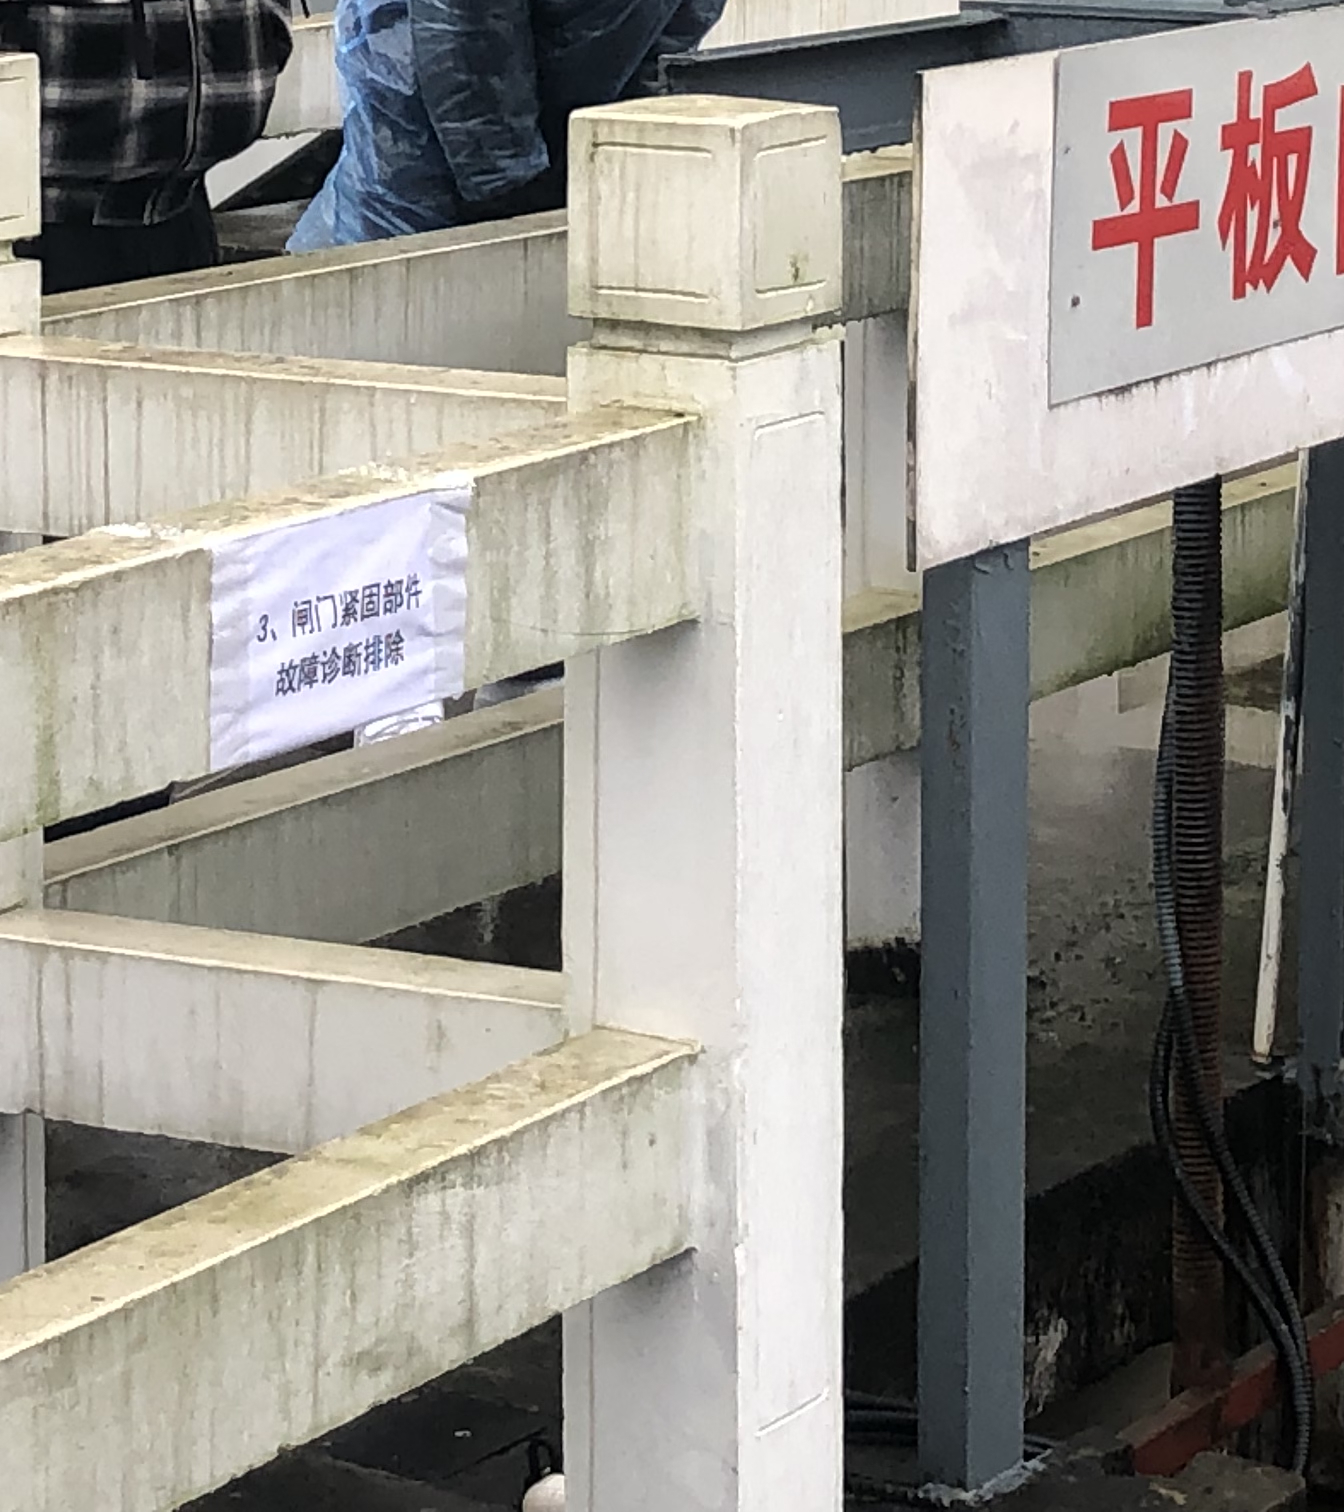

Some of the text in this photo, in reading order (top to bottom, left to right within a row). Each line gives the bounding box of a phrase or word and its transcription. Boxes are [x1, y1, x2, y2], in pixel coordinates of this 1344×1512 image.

[256, 573, 423, 643] 3、闸门紧固部件
[275, 629, 405, 697] 故障诊断排除
